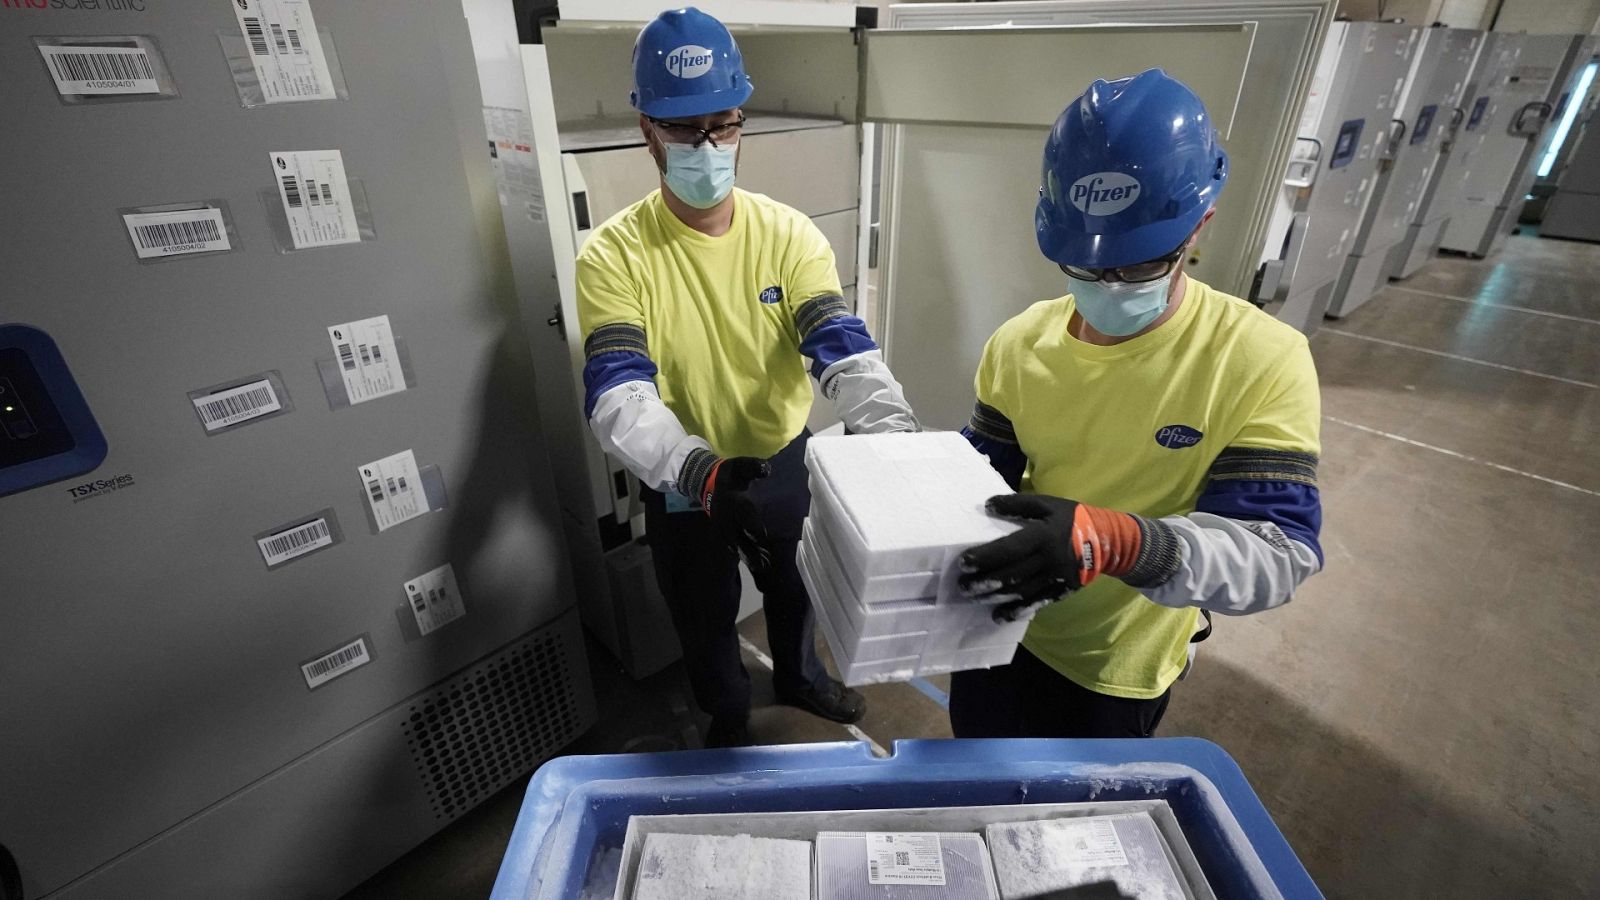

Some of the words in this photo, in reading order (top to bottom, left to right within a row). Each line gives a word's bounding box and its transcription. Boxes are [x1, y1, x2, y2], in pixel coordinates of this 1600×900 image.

[669, 49, 711, 78] Pfizer
[85, 80, 136, 89] 4105004/01
[1073, 177, 1138, 214] Pfizer
